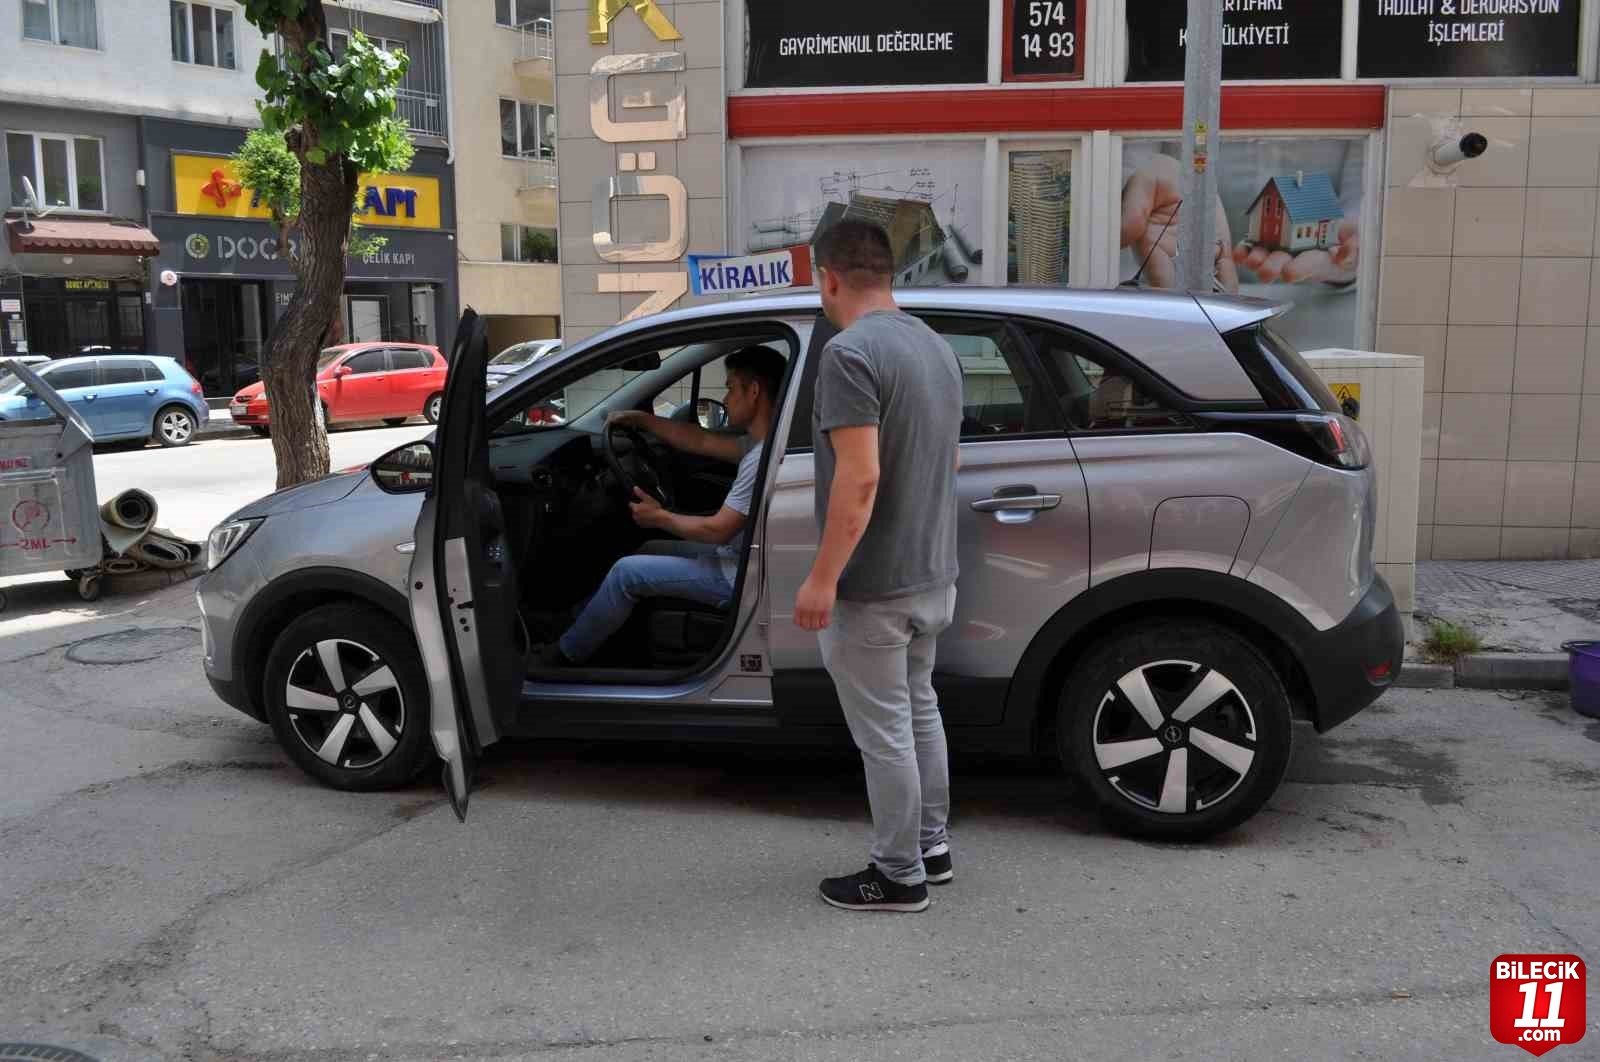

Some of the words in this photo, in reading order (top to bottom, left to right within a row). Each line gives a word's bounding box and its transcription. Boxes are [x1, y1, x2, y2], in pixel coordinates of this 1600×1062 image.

[1029, 1, 1066, 27] 574
[1440, 0, 1457, 15] &
[1460, 0, 1561, 15] DEKORASYON
[779, 33, 873, 56] GAYRİMENKUL
[876, 31, 954, 53] DEĞERLEME
[1021, 32, 1043, 59] 14
[1048, 31, 1075, 58] 93
[1221, 22, 1290, 46] ÜLKİYETİ
[1427, 18, 1505, 47] İŞLEMLERİ
[700, 260, 791, 290] KİRALIK
